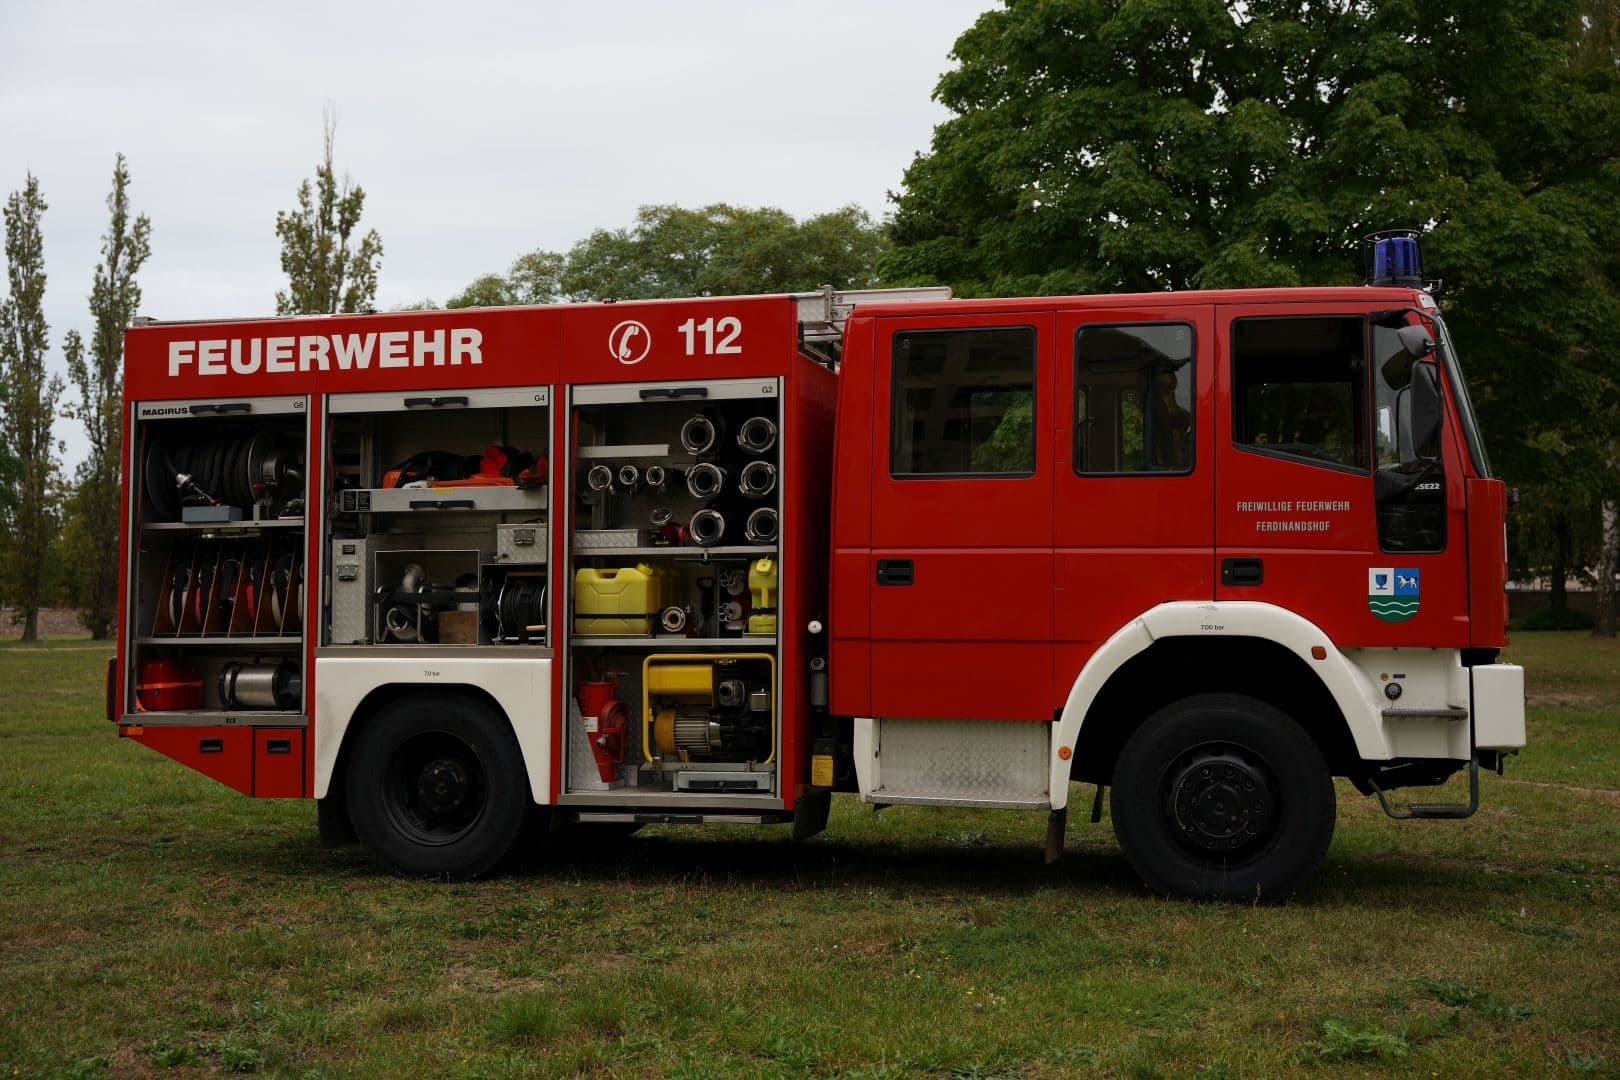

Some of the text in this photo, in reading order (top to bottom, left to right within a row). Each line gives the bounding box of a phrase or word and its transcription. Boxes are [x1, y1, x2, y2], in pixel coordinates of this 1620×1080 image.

[677, 315, 743, 356] 112
[168, 328, 483, 377] FEUERWEHR
[761, 385, 774, 394] G2
[534, 394, 545, 402] G4
[142, 407, 189, 417] MAGIRUS
[1236, 501, 1350, 512] FREIWILLIGE FEUERWEHR
[1256, 521, 1331, 532] FERDINANDSHOF
